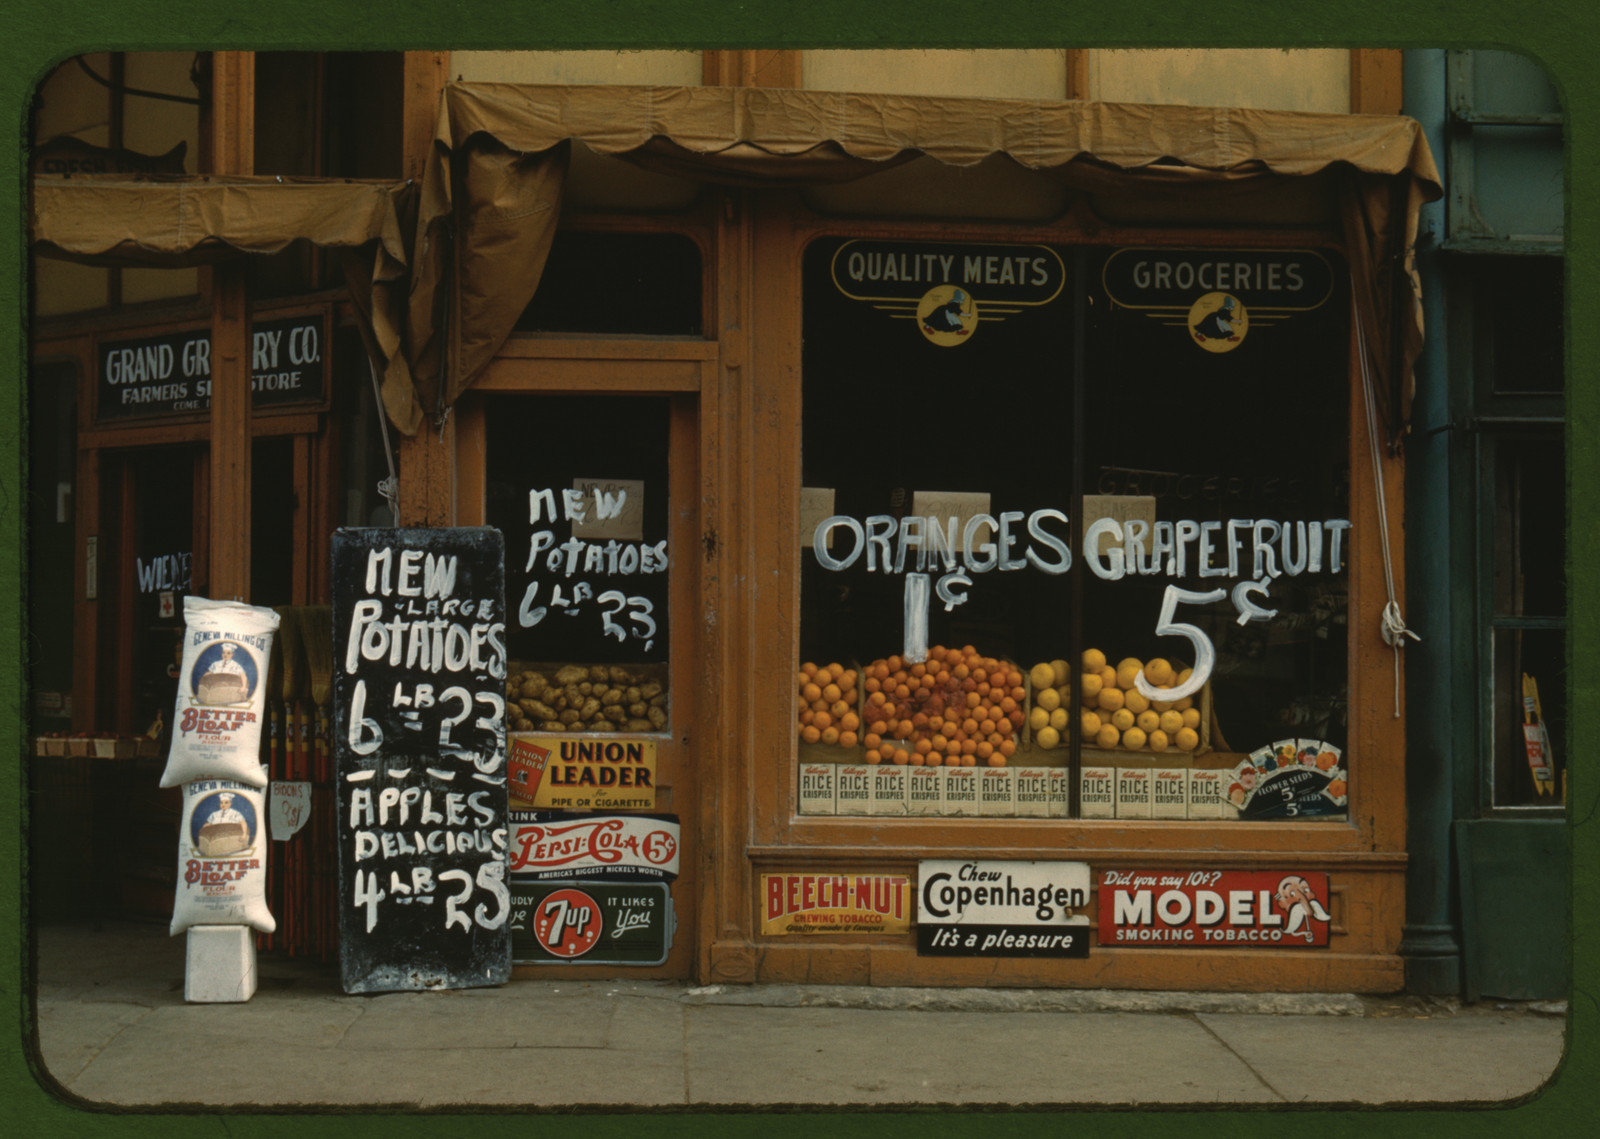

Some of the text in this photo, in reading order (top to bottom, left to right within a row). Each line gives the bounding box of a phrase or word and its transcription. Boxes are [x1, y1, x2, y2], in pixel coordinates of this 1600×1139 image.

[848, 253, 1048, 286] QUALITY MEATS
[1132, 261, 1304, 291] GROCERIES
[106, 343, 174, 385] GRAND
[288, 325, 320, 366] CO.
[121, 382, 188, 405] FARMERS
[813, 508, 1072, 575] ORANGES
[1083, 517, 1352, 581] GRAPEFRUIT
[180, 706, 257, 738] BETTER
[347, 678, 384, 756] 6
[195, 719, 243, 735] LOAF
[515, 747, 544, 762] UNION
[560, 742, 644, 764] UNION
[510, 754, 544, 771] LEADER
[551, 765, 654, 788] LEADER
[803, 775, 832, 790] RICE
[840, 776, 869, 790] RICE
[875, 776, 904, 790] RICE
[911, 777, 940, 791] RICE
[1288, 771, 1313, 785] SEEDS
[946, 778, 976, 792] RICE
[982, 778, 1011, 792] RICE
[1017, 778, 1046, 793] RICE
[1082, 779, 1112, 794] RICE
[1120, 780, 1149, 794] RICE
[1155, 780, 1184, 795] RICE
[1191, 781, 1220, 795] RICE
[803, 790, 832, 799] KRISPIES
[840, 790, 869, 800] KRISPIES
[875, 790, 904, 800] KRISPIES
[911, 791, 940, 801] KRISPIES
[946, 792, 976, 801] KRISPIES
[982, 792, 1011, 802] KRISPIES
[1017, 793, 1046, 802] KRISPIES
[1082, 794, 1112, 803] KRISPIES
[1120, 794, 1149, 803] KRISPIES
[1155, 795, 1184, 804] KRISPIES
[1191, 795, 1220, 804] KRISPIES
[350, 785, 496, 829] APPLES
[551, 798, 572, 807] PIPE
[576, 798, 591, 807] OR
[508, 811, 538, 821] RINK
[354, 829, 508, 862] DELICIOUS
[647, 832, 676, 863] 5¢
[184, 858, 260, 890] BETTER
[199, 870, 247, 886] LOAF
[575, 866, 604, 876] BIGGEST
[638, 867, 664, 878] WORTH
[958, 864, 1002, 882] Chew
[1104, 870, 1135, 886] Did
[1134, 875, 1157, 890] you
[1159, 874, 1183, 889] say
[354, 868, 386, 933] 4
[608, 897, 655, 906] IT LIKES
[923, 872, 1085, 921] Copenhagen
[1113, 889, 1282, 926] MODEL
[611, 908, 652, 939] You
[794, 914, 882, 924] CHEWING TOBACCO
[931, 927, 1073, 951] It's a pleasure
[1116, 928, 1283, 942] SMOKING TOBACCO
